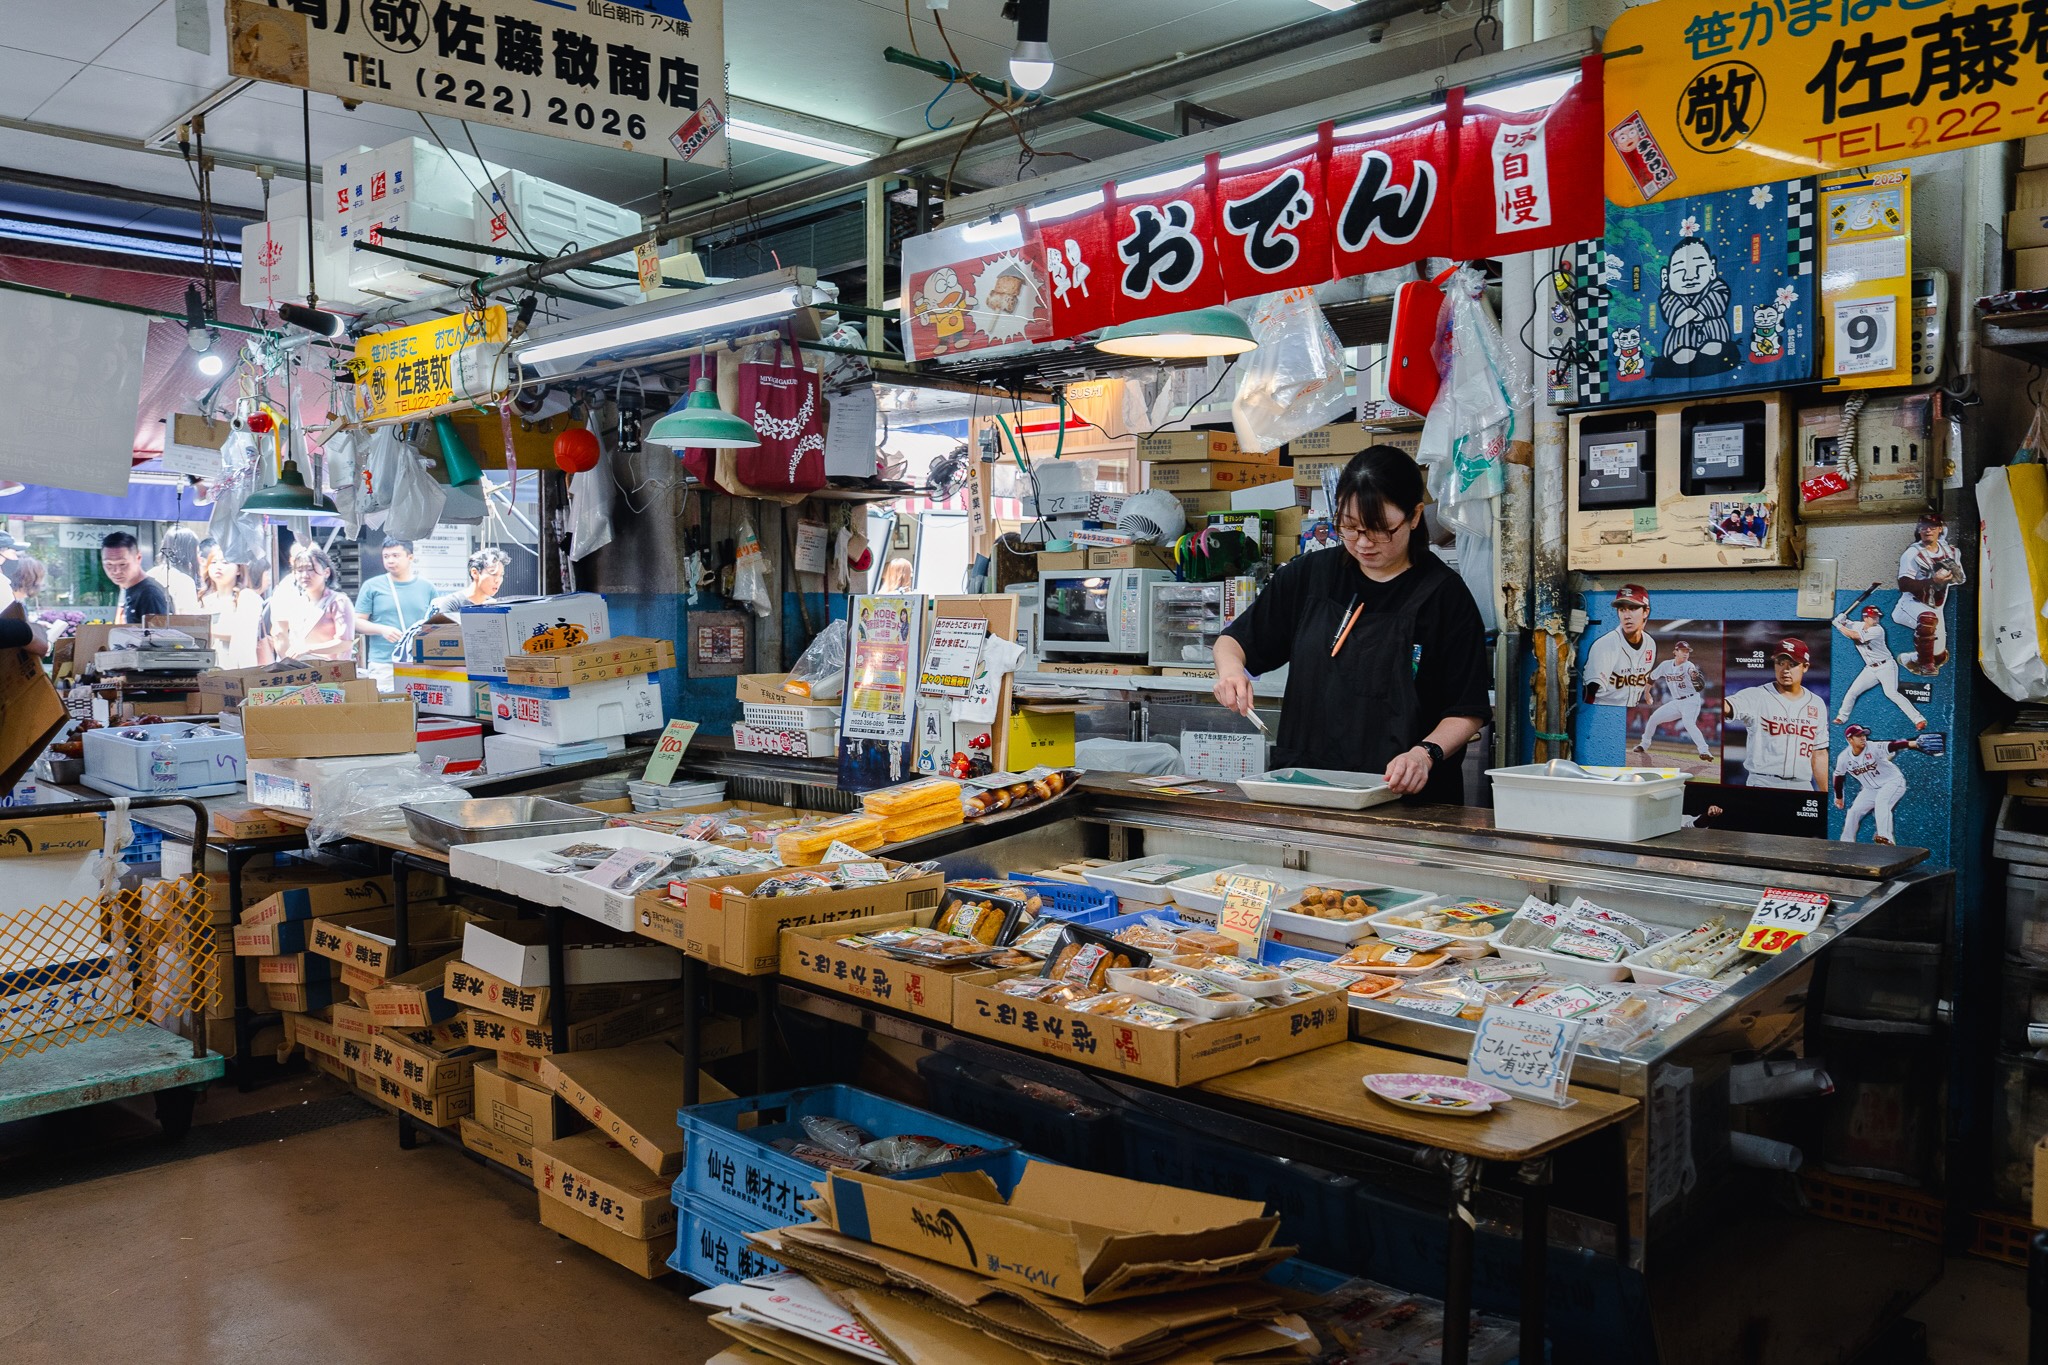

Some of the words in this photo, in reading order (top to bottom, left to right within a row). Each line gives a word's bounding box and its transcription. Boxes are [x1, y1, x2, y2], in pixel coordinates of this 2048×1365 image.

[433, 0, 700, 112] 佐藤敬商店
[343, 52, 392, 91] TEL
[547, 96, 648, 141] 2026
[1684, 69, 1757, 147] 敬
[1873, 171, 1904, 187] 2025
[1117, 149, 1439, 300] おでん
[1846, 314, 1879, 355] 9
[371, 336, 418, 364] 笹かまぼこ
[371, 367, 387, 402] 敬
[394, 353, 453, 399] 佐藤敬
[1620, 469, 1628, 477] 72
[873, 609, 897, 620] KOBE
[1752, 650, 1765, 658] 28
[1904, 689, 1931, 697] TOSHIKI
[1766, 719, 1818, 741] EAGLES
[1805, 799, 1818, 807] 56
[1225, 910, 1261, 931] 250
[1758, 899, 1823, 923] ちくわぶ
[315, 929, 341, 950] 水産
[452, 971, 484, 996] 水産
[798, 948, 893, 1000] 笹かまぼこ
[473, 1017, 506, 1042] 水産
[975, 998, 1098, 1055] 笹かまぼこ
[1482, 1036, 1543, 1062] こんにゃく
[1499, 1058, 1549, 1079] 有ります
[707, 1153, 737, 1186] 仙台
[561, 1170, 627, 1222] 笹かまぼこ
[700, 1226, 729, 1261] 仙台
[985, 1253, 1061, 1289] ノルウェー産
